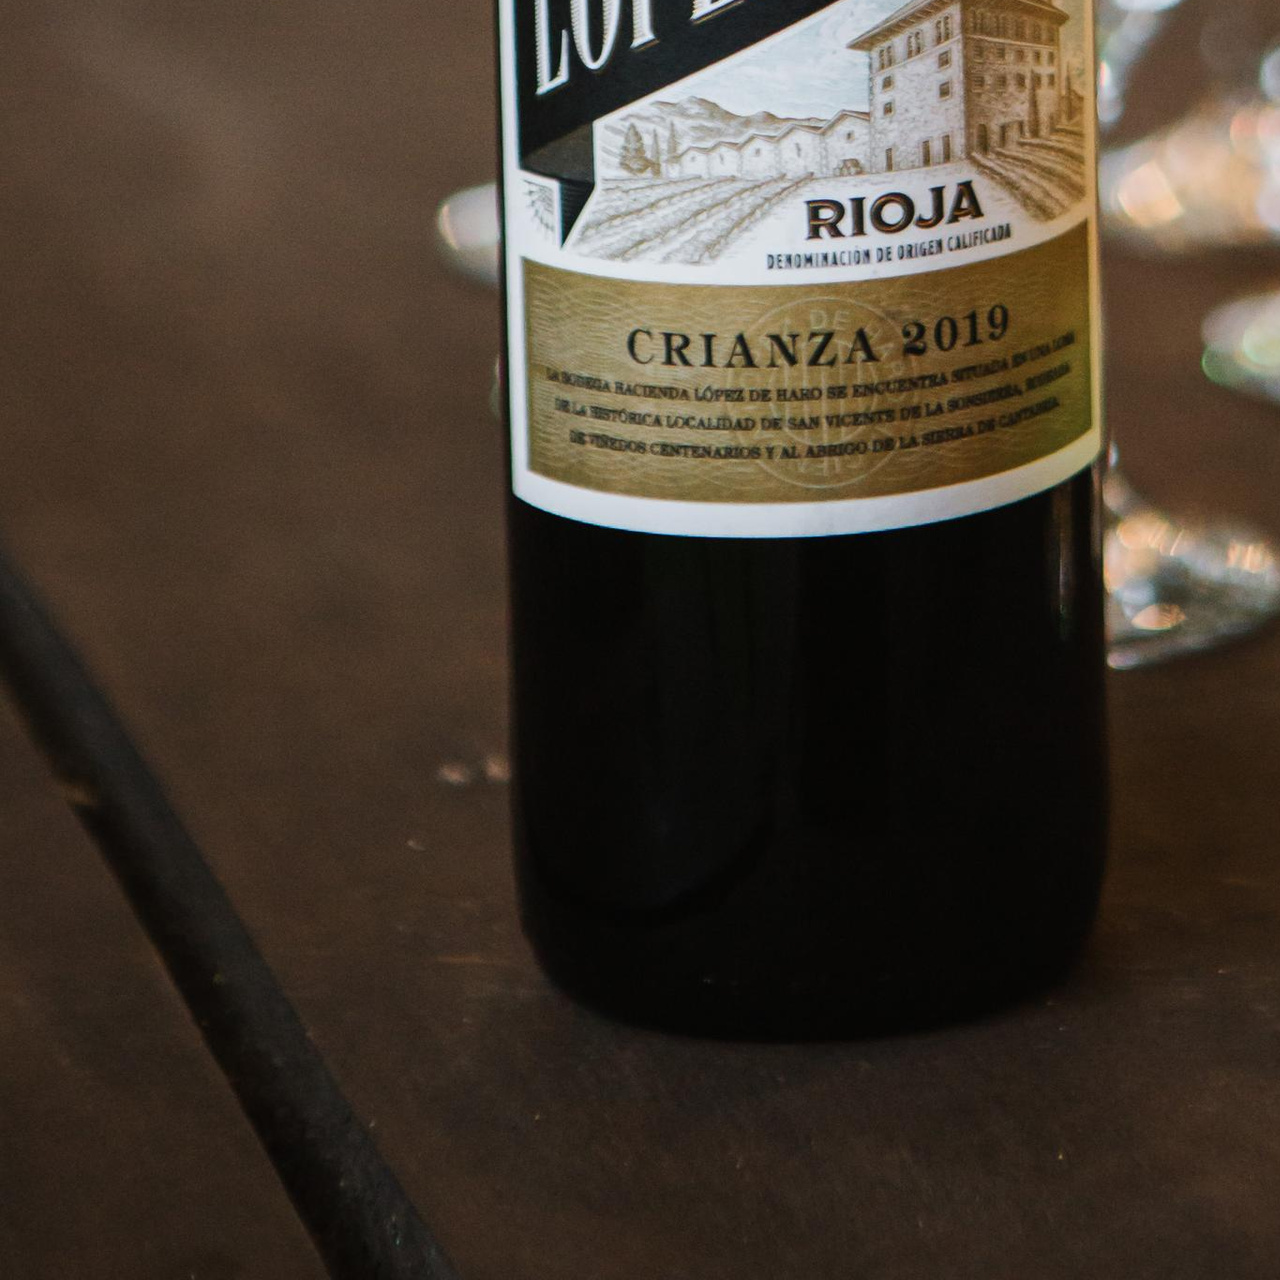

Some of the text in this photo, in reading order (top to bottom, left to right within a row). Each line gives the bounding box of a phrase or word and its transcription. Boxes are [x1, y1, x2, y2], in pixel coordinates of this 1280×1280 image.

[804, 179, 985, 241] RIOJA
[876, 245, 893, 263] DE
[897, 238, 944, 260] ORIGEN
[947, 222, 1012, 252] CALIFICADA
[626, 326, 881, 370] CRIANZA
[902, 304, 1010, 357] 2019
[749, 388, 772, 402] DE
[776, 388, 823, 402] HARO
[827, 386, 847, 399] SE
[761, 416, 783, 431] DE
[787, 416, 820, 430] SAN
[900, 405, 922, 420] DE
[925, 402, 944, 417] LA
[765, 446, 776, 460] Y
[780, 446, 800, 459] AL
[872, 438, 896, 454] DE
[899, 436, 918, 449] LA
